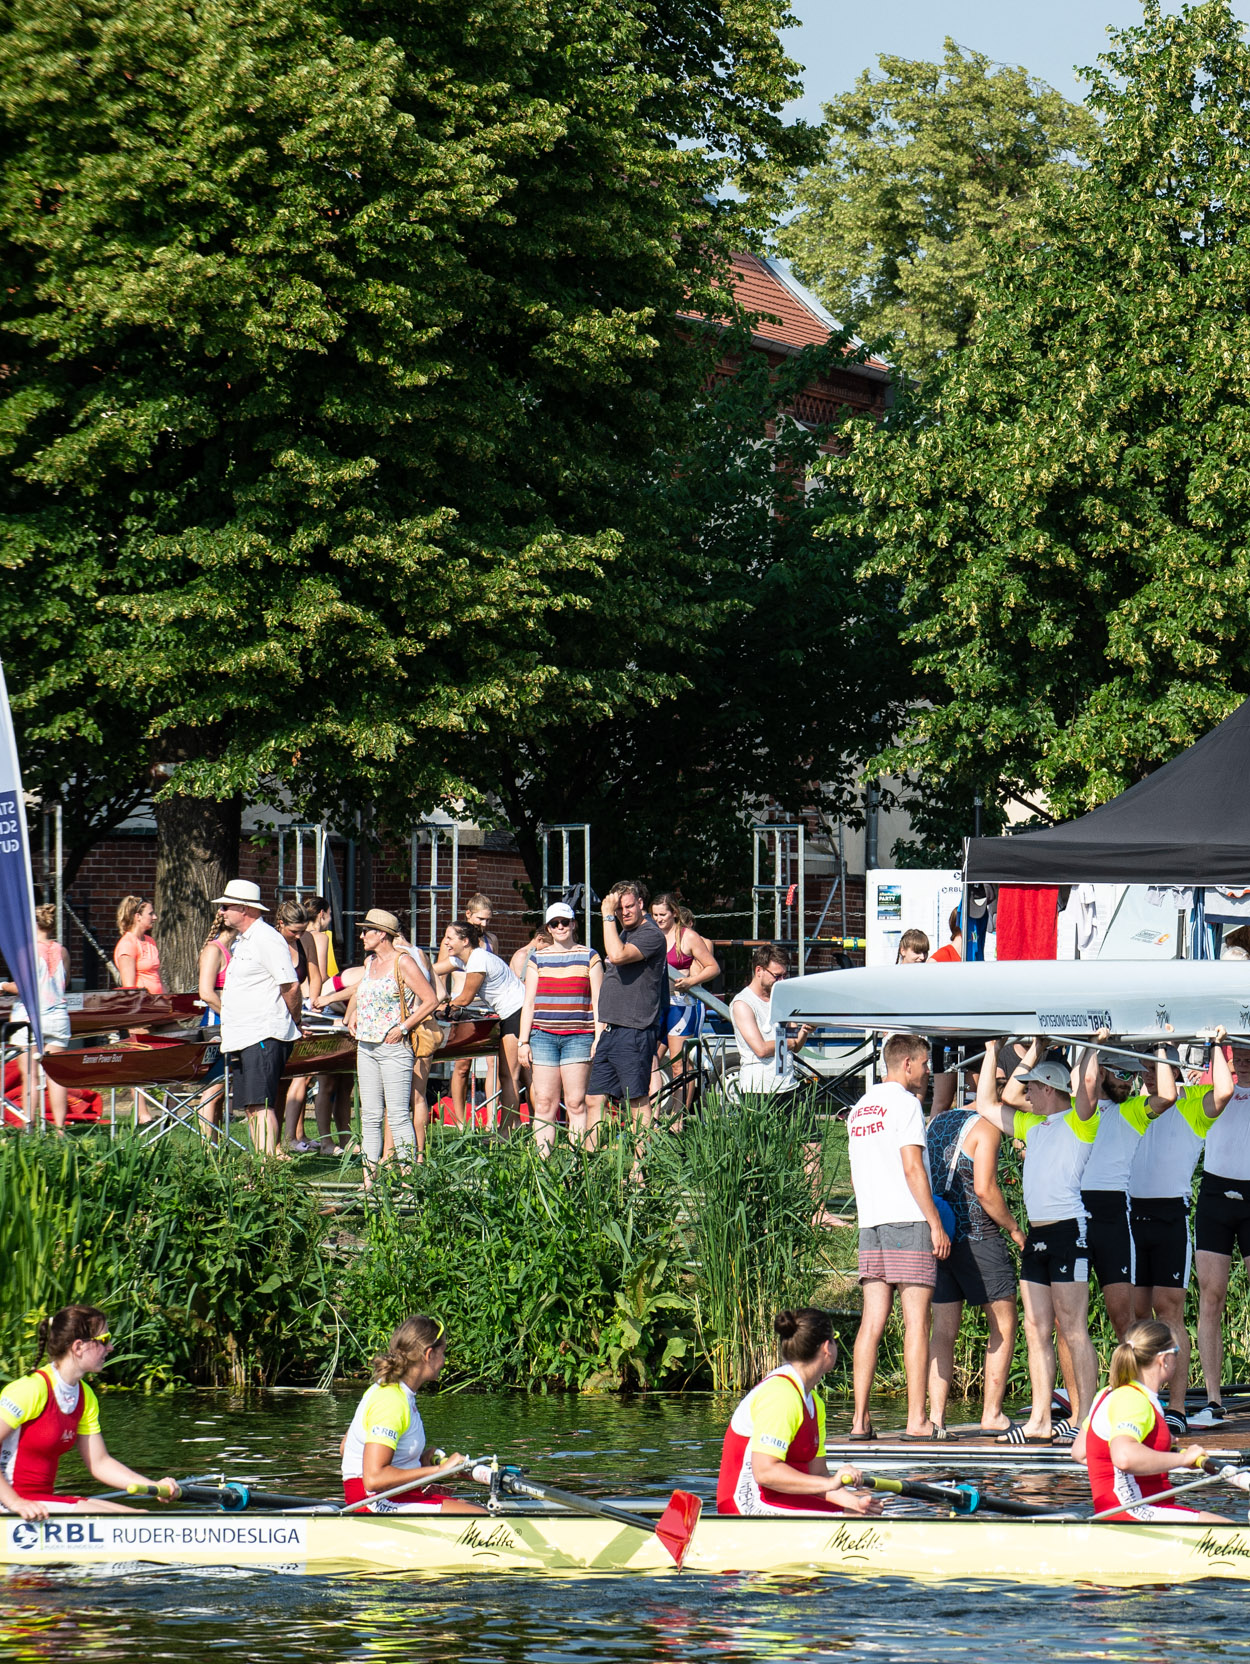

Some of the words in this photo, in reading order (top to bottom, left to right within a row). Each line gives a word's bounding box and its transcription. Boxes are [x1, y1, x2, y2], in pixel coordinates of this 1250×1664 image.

[381, 1427, 398, 1440] RBL
[44, 1523, 104, 1543] RBL
[113, 1527, 300, 1544] RUDER-BUNDESLIGA
[455, 1522, 516, 1550] Melitta
